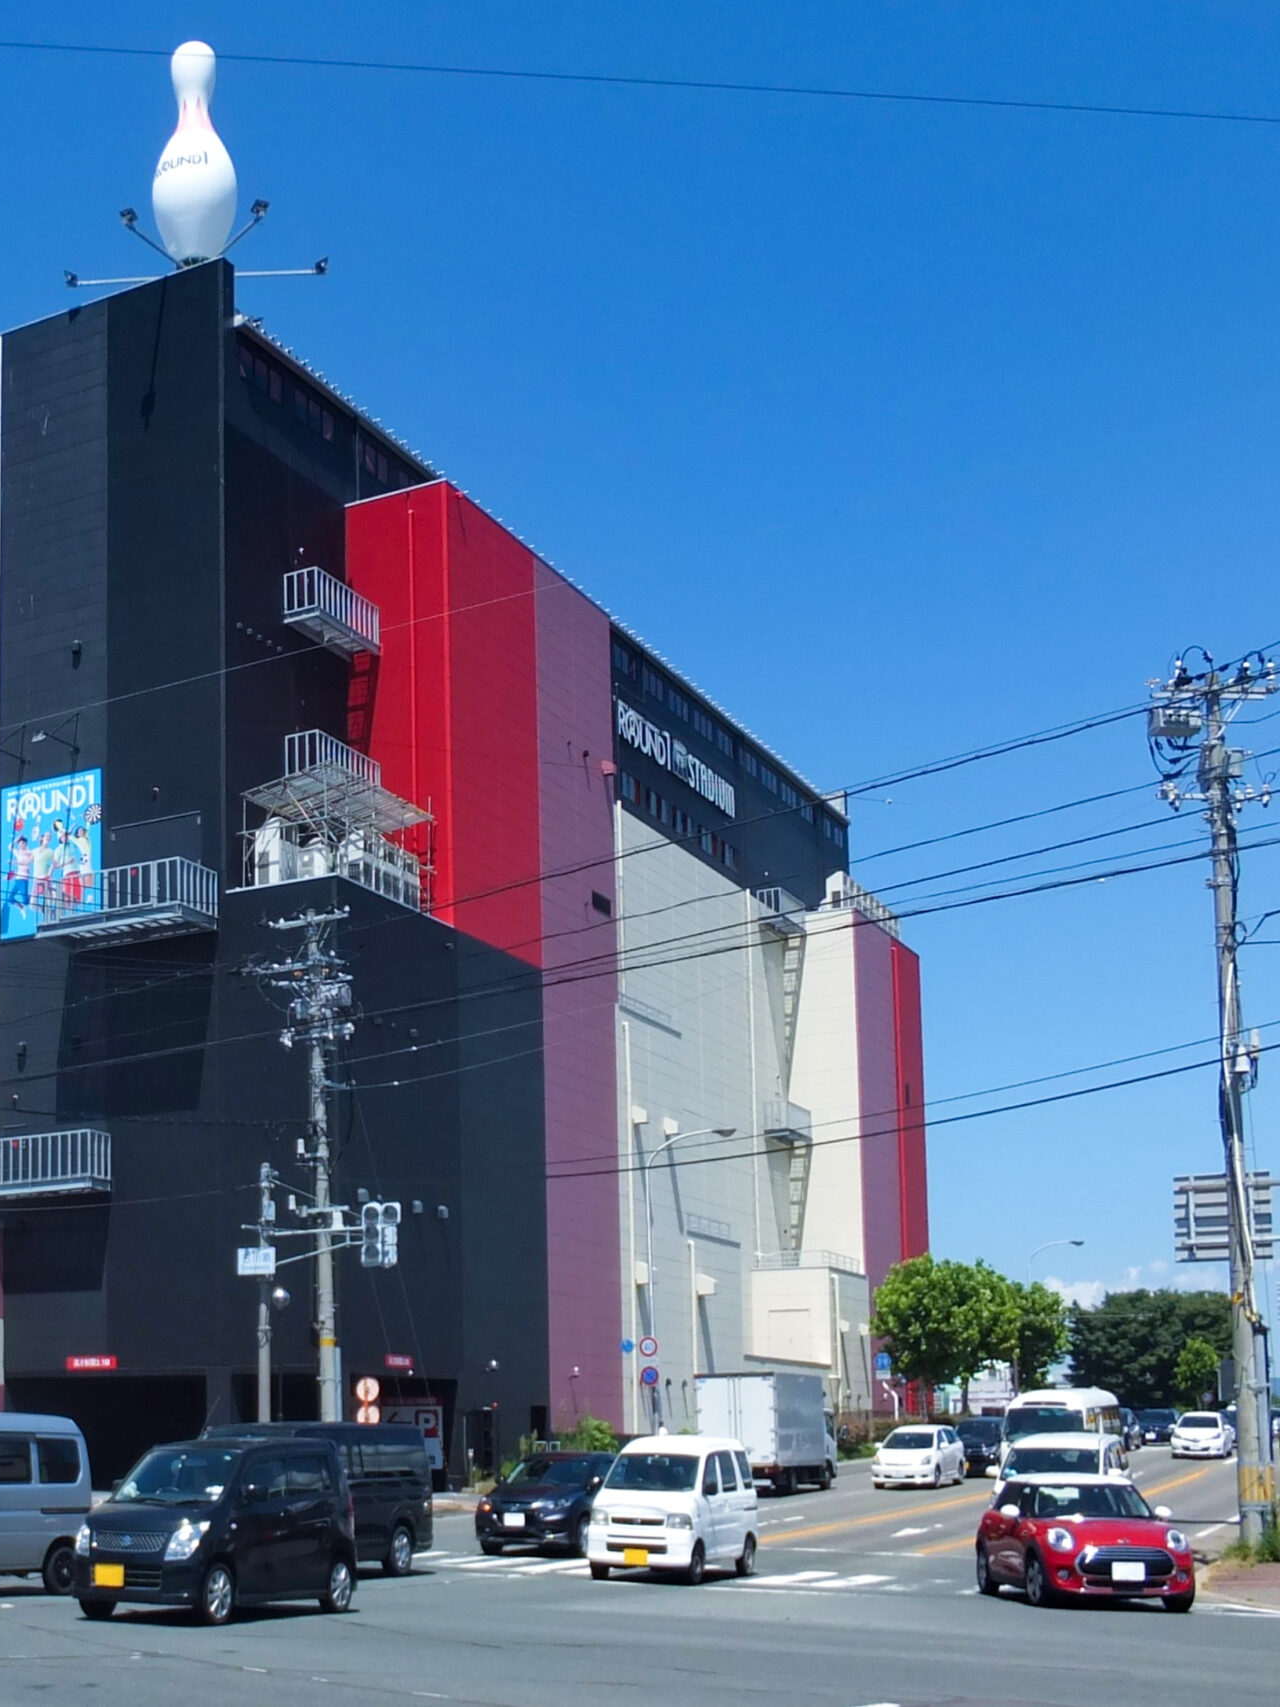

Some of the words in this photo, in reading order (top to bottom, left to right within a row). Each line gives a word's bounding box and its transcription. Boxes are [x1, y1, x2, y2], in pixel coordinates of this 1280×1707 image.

[6, 774, 95, 822] ROUND1
[618, 699, 671, 771] ROUND1
[687, 753, 735, 819] STADIUM
